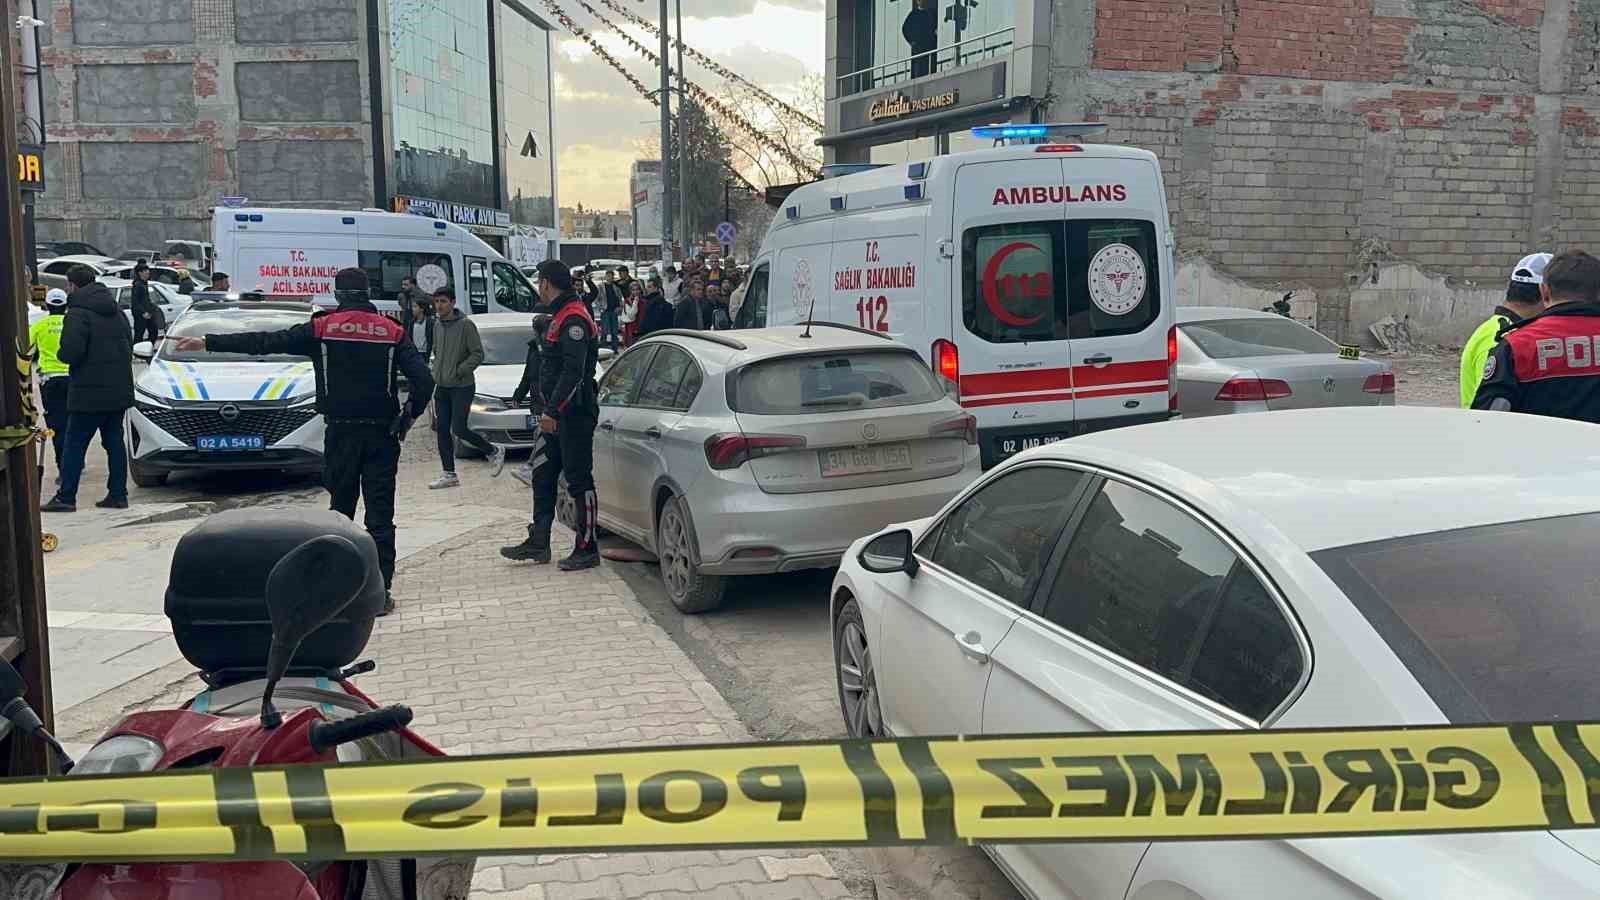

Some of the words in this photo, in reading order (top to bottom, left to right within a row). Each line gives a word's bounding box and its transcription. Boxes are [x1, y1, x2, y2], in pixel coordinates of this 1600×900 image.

[992, 184, 1127, 206] AMBULANS
[453, 205, 476, 224] PARK
[477, 208, 495, 225] AVM
[290, 250, 308, 262] T.C.
[865, 241, 880, 262] T.C.
[259, 264, 290, 278] SAĞLIK
[834, 267, 862, 291] SAĞLIK
[866, 262, 915, 289] BAKANLIĞI
[272, 280, 294, 294] ACİL
[296, 280, 331, 294] SAĞLIK
[856, 296, 889, 332] 112
[326, 322, 389, 336] POLİS
[200, 438, 215, 448] 02
[219, 438, 228, 448] A
[231, 437, 261, 448] 5419
[1003, 440, 1017, 453] 02
